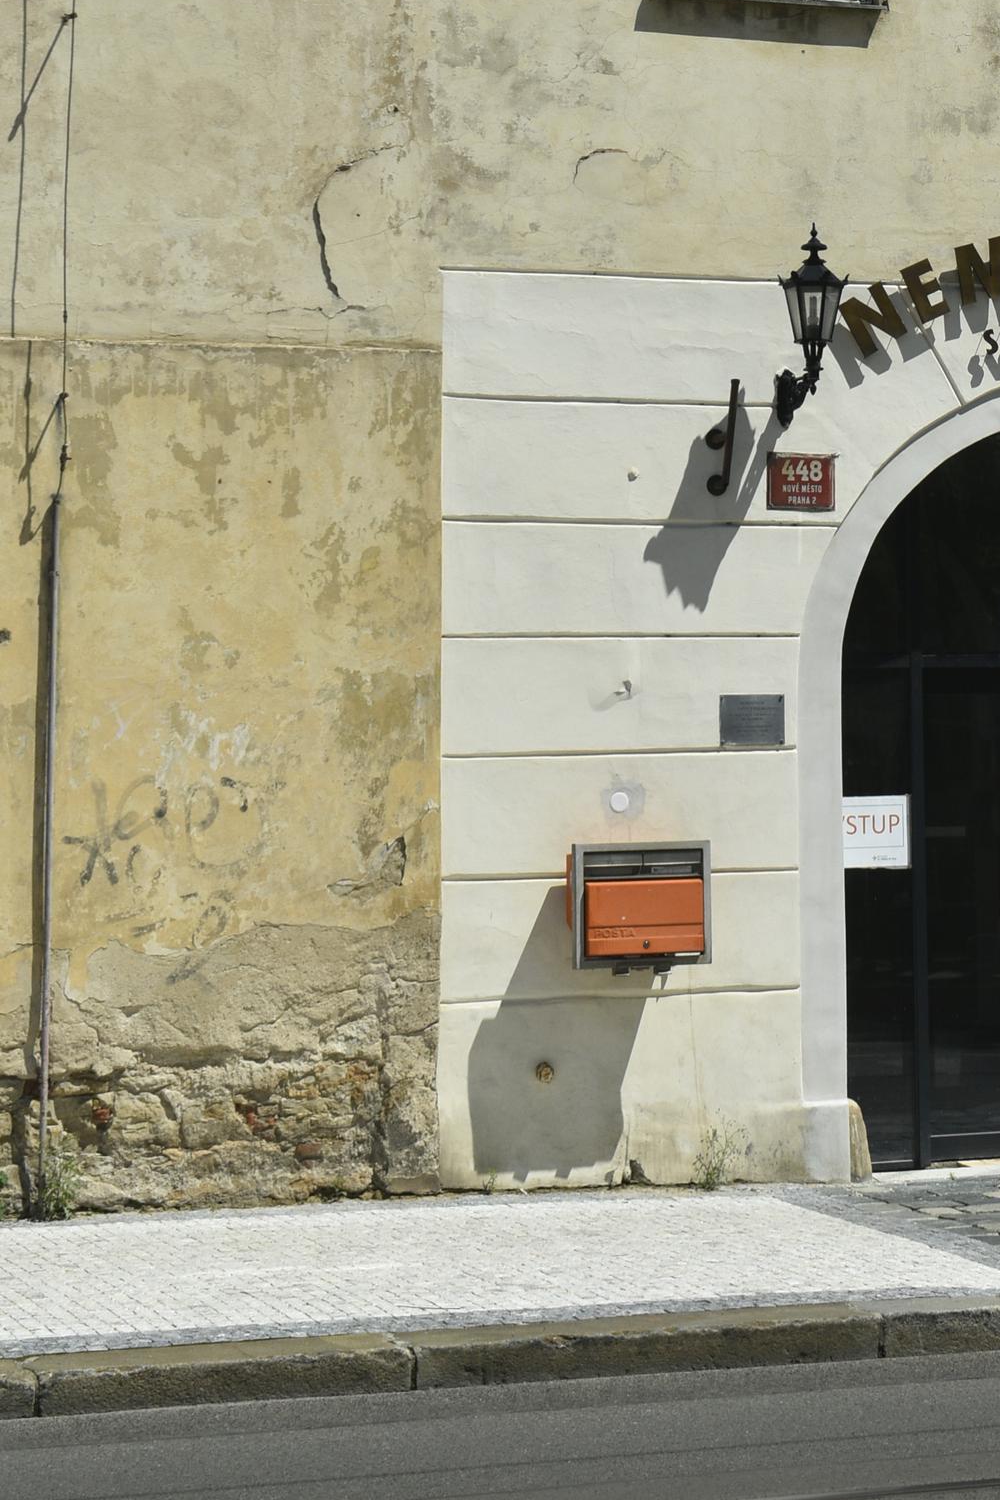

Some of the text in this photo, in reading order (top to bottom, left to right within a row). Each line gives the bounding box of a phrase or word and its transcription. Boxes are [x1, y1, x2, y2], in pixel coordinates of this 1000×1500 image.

[781, 459, 823, 482] 448
[782, 483, 800, 493] NOVÉ
[787, 496, 817, 505] PRAHA 2
[842, 814, 900, 835] STUP
